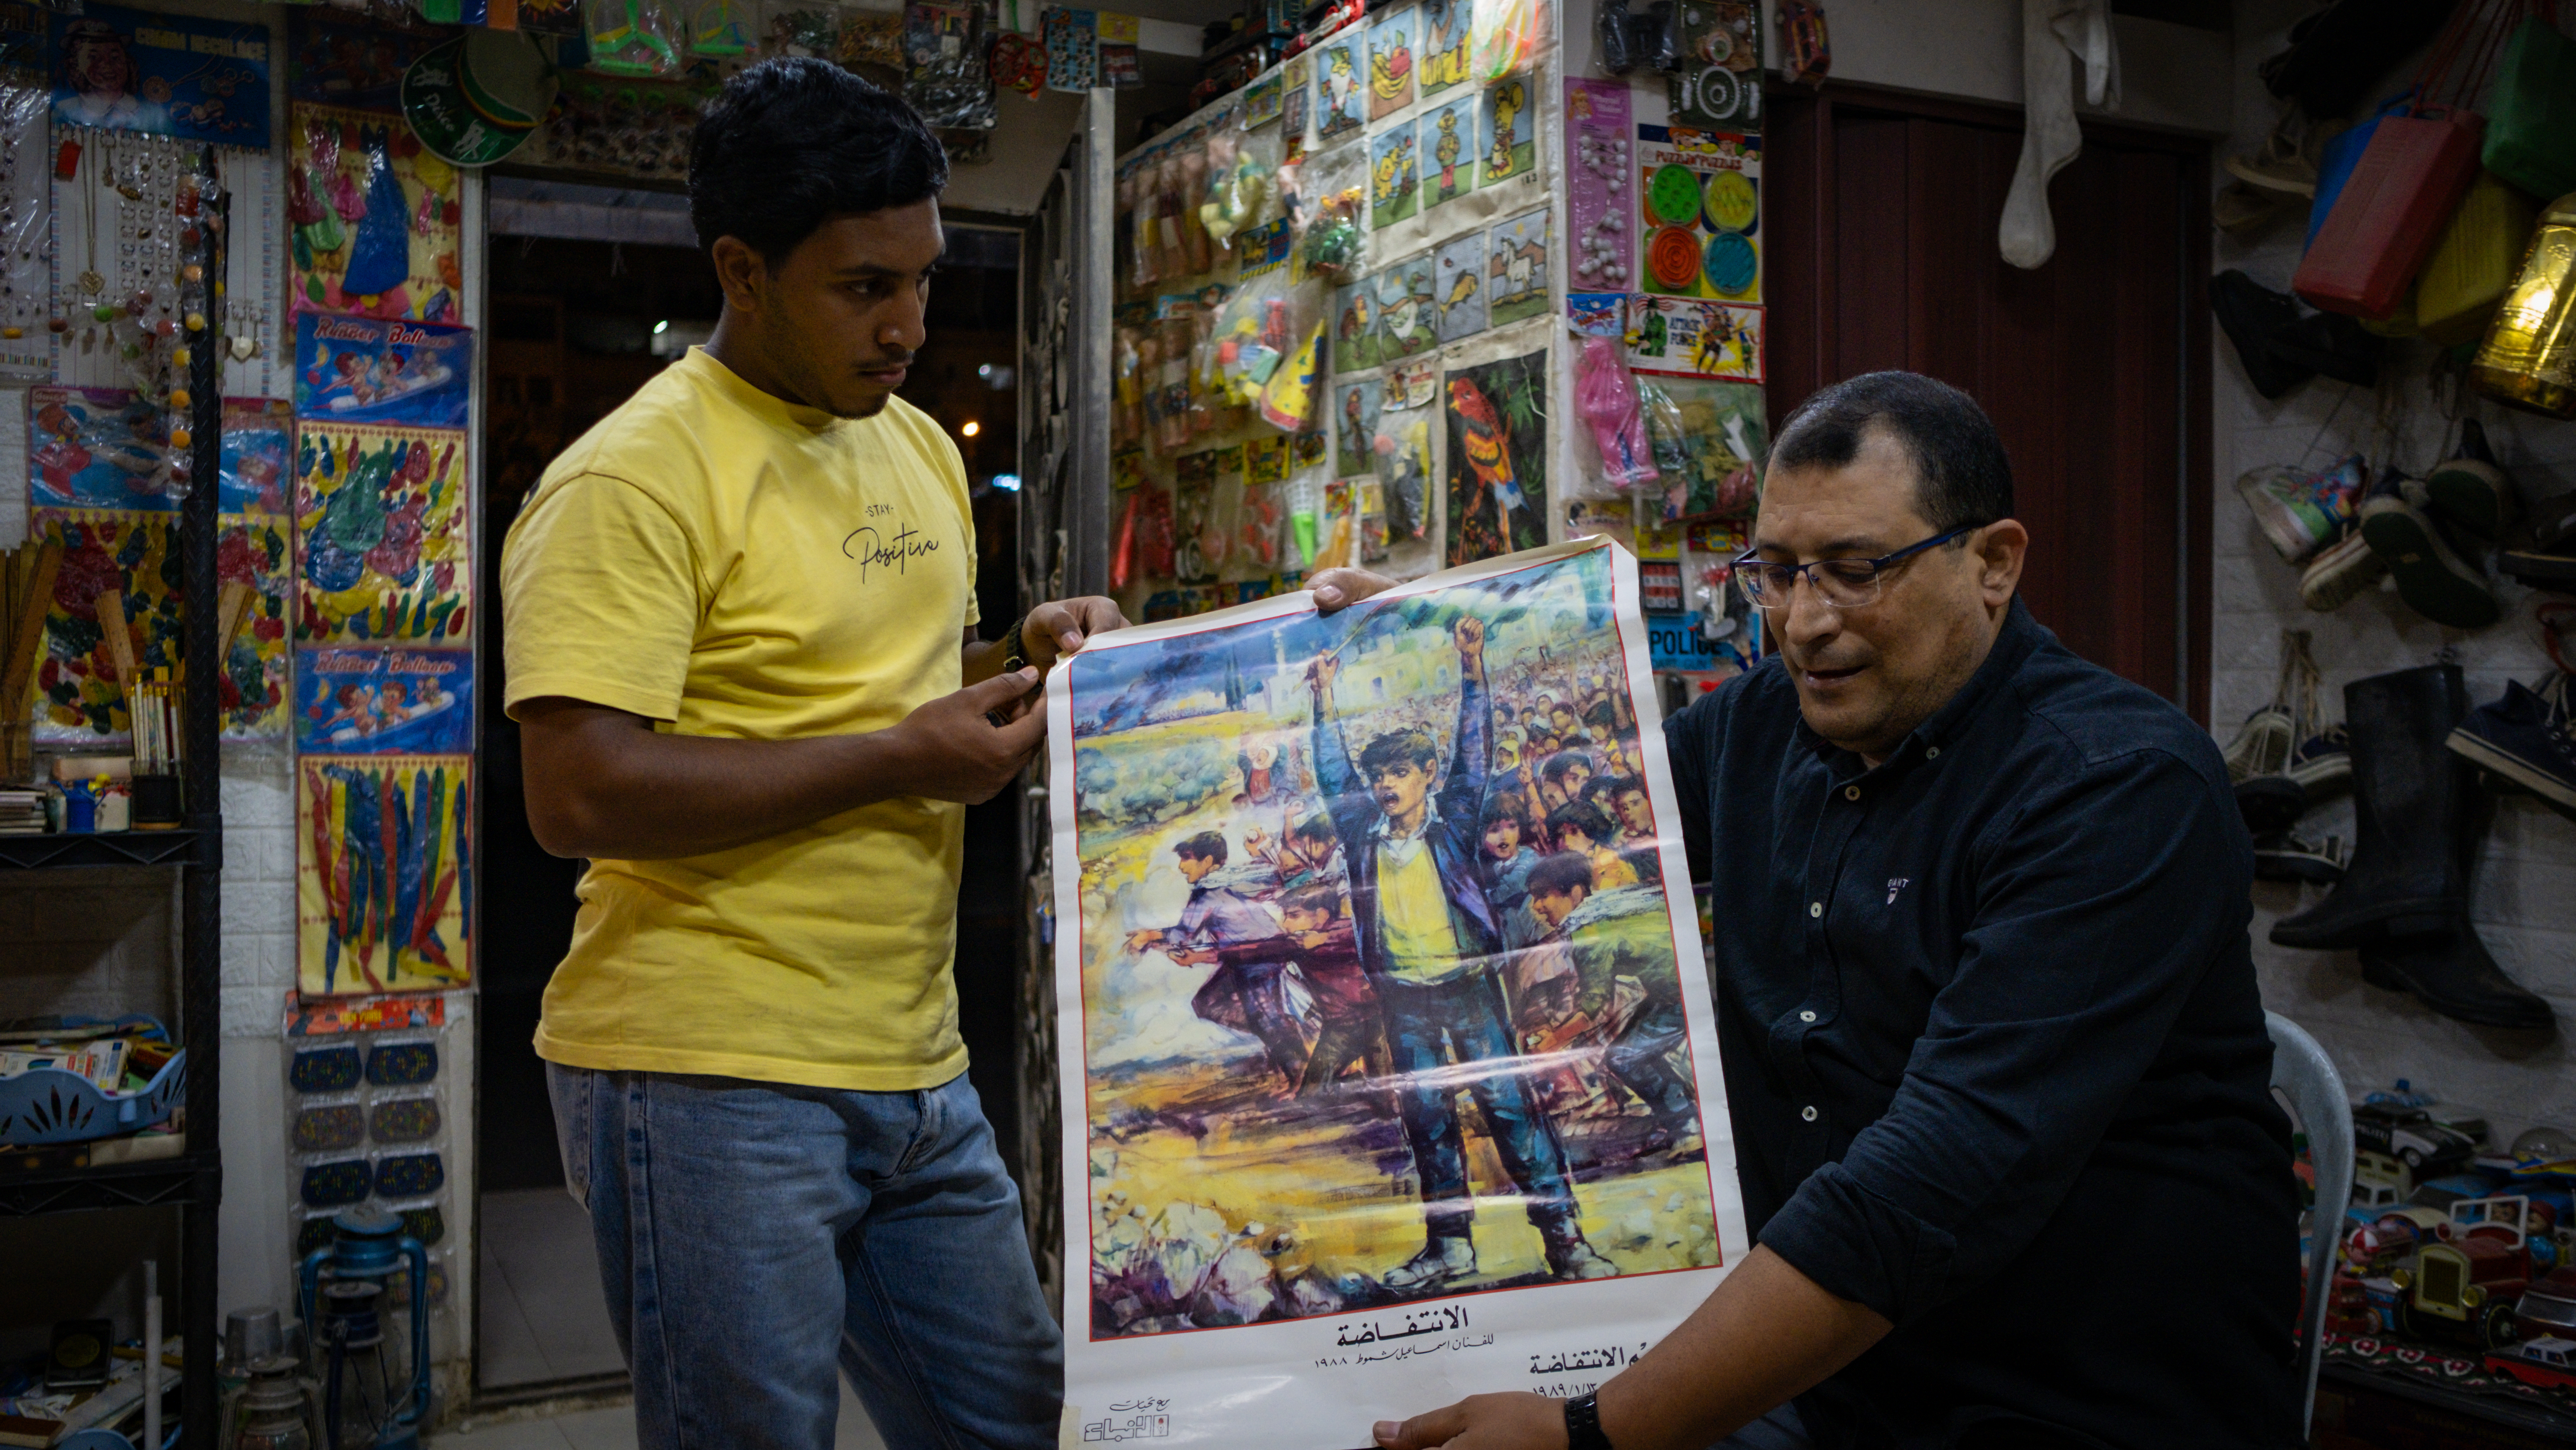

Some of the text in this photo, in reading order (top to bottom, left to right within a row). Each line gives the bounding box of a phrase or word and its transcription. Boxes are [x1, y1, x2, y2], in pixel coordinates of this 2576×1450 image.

[843, 522, 938, 585] Positive
[1887, 878, 1909, 888] GANT
[1337, 1305, 1468, 1347] الانتفاضة
[1314, 1333, 1494, 1368] للفنان اسماعيل شموط ١٩٨٨
[1530, 1346, 1625, 1374] الانتفاضة
